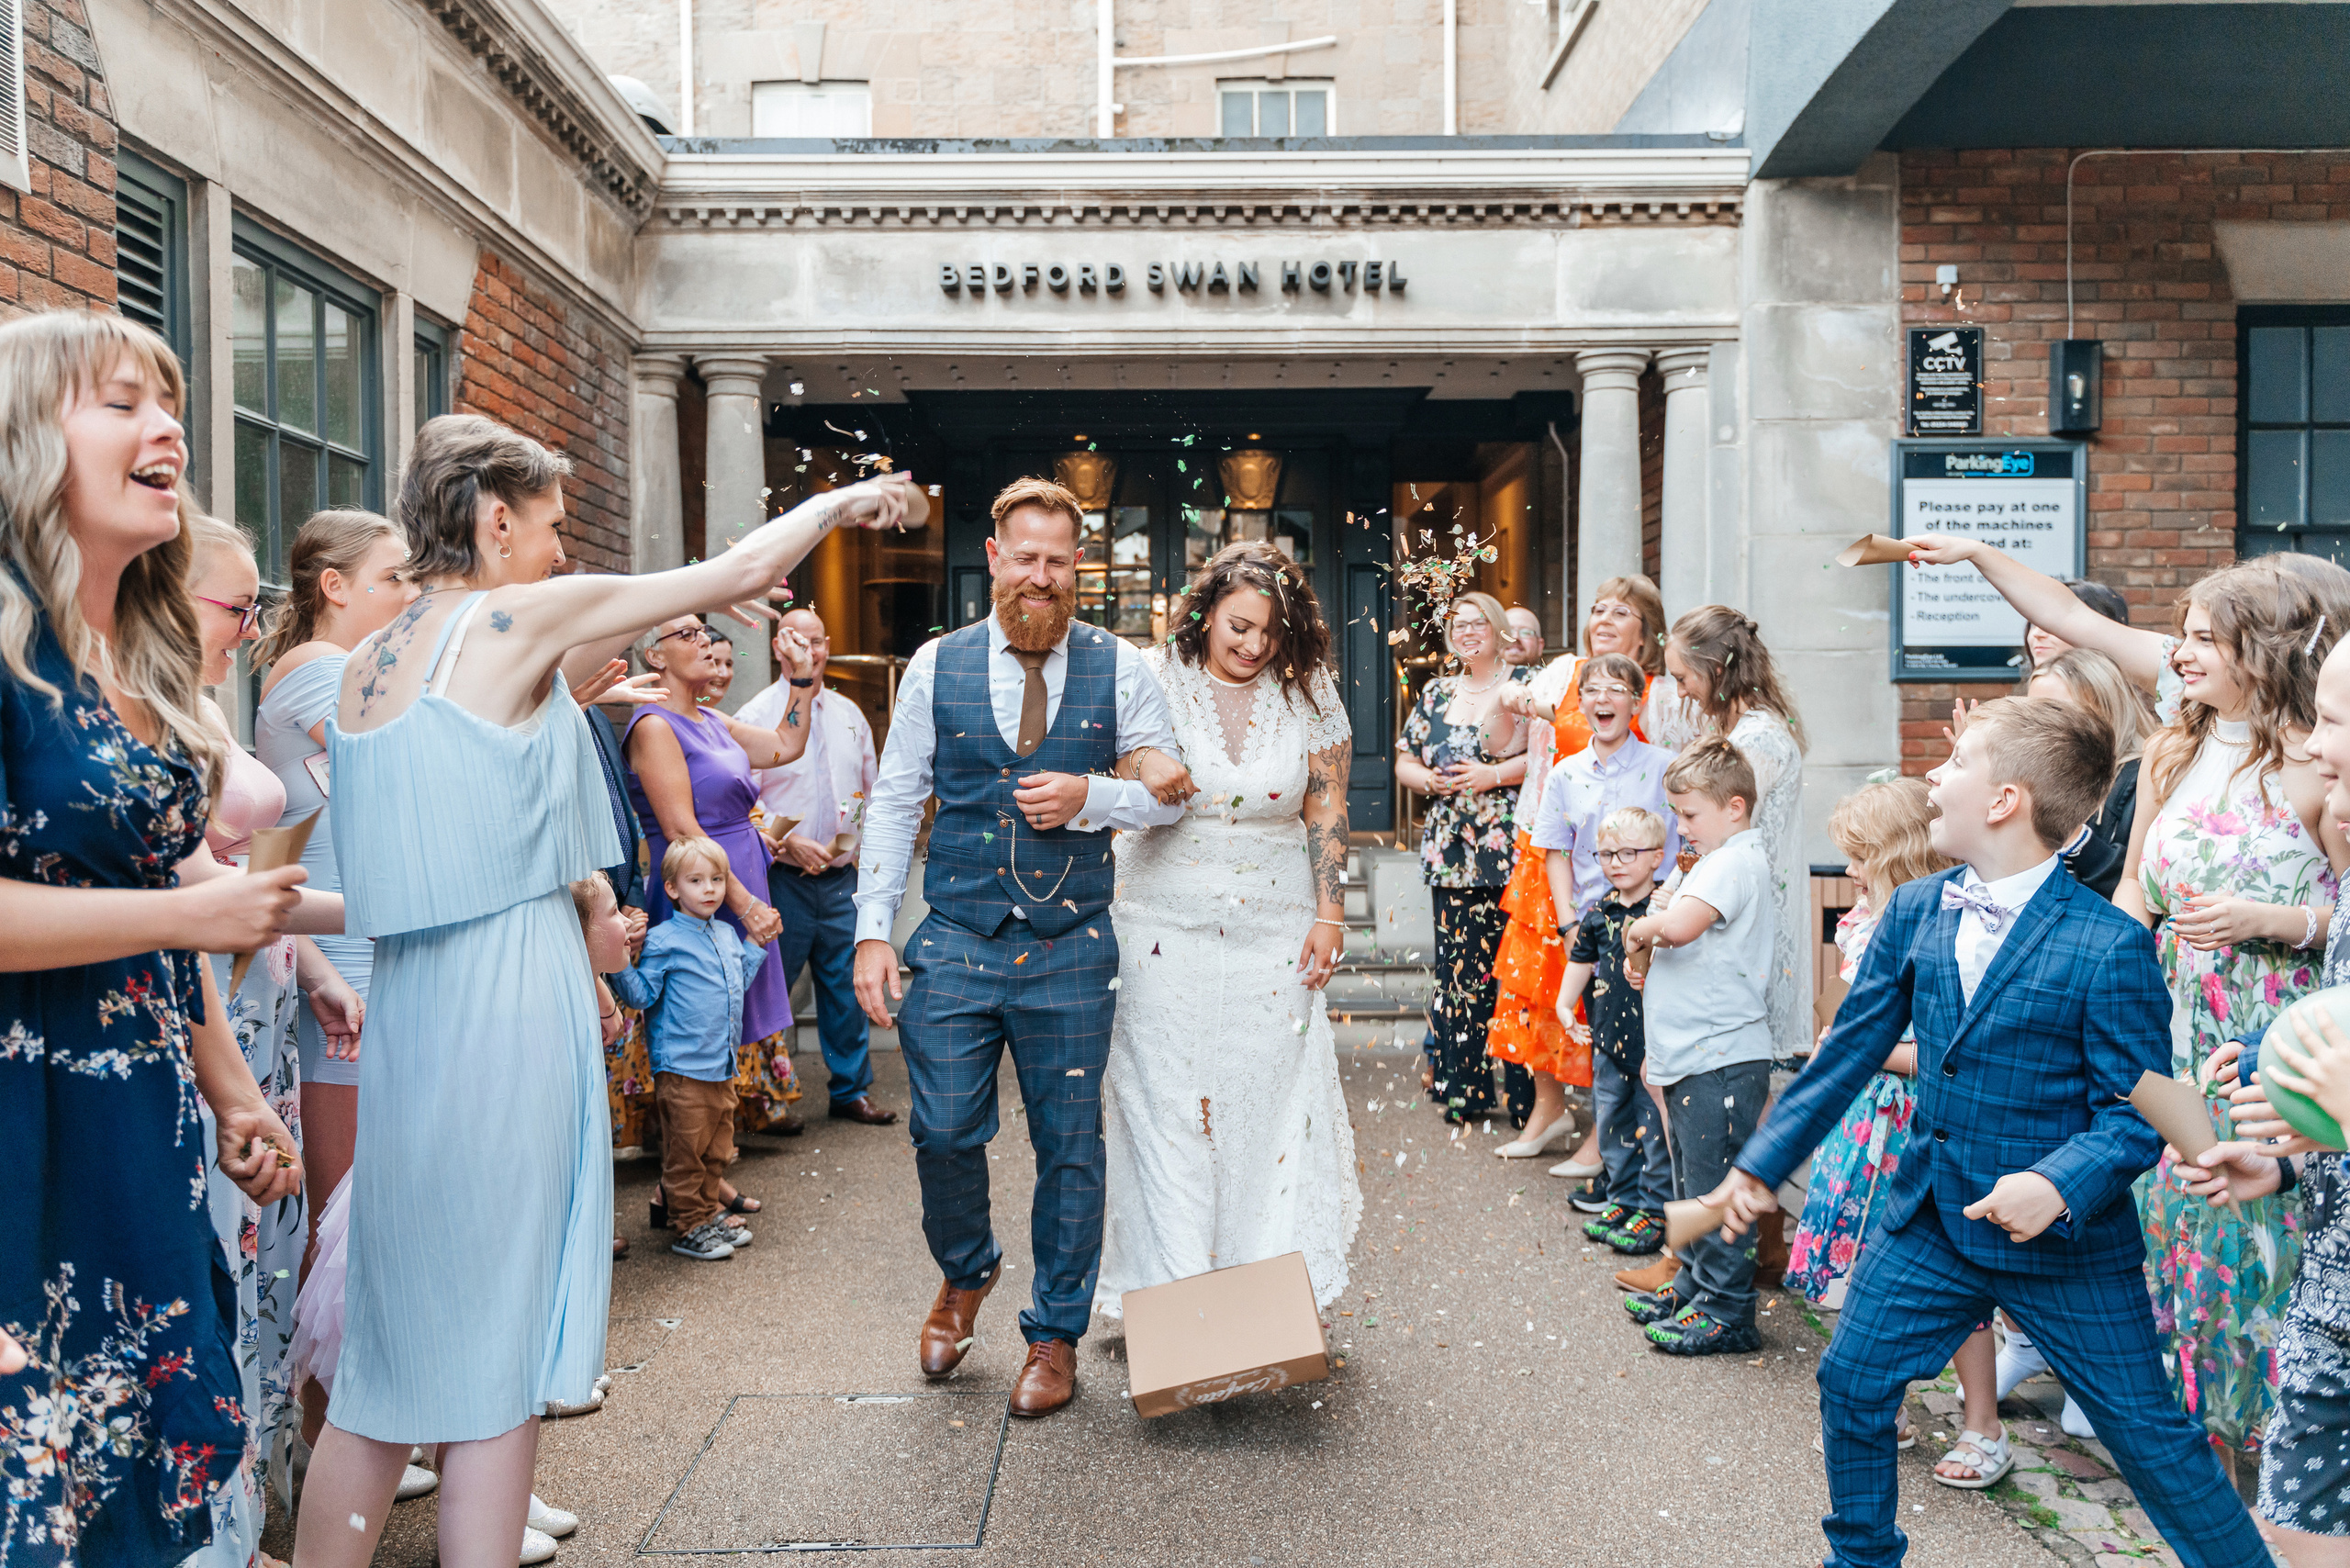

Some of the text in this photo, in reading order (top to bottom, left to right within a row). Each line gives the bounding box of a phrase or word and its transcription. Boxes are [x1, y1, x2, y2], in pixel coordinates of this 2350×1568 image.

[938, 260, 1408, 293] BEDFORD SWAN HOTEL
[1923, 356, 1966, 370] CCTV
[1919, 501, 2061, 515] Please pay at one
[1926, 520, 2053, 531] of the machines
[1943, 573, 1975, 583] front
[1942, 592, 2006, 602] undercov
[1916, 610, 1980, 622] Reception
[1192, 1377, 1271, 1404] Confetti
